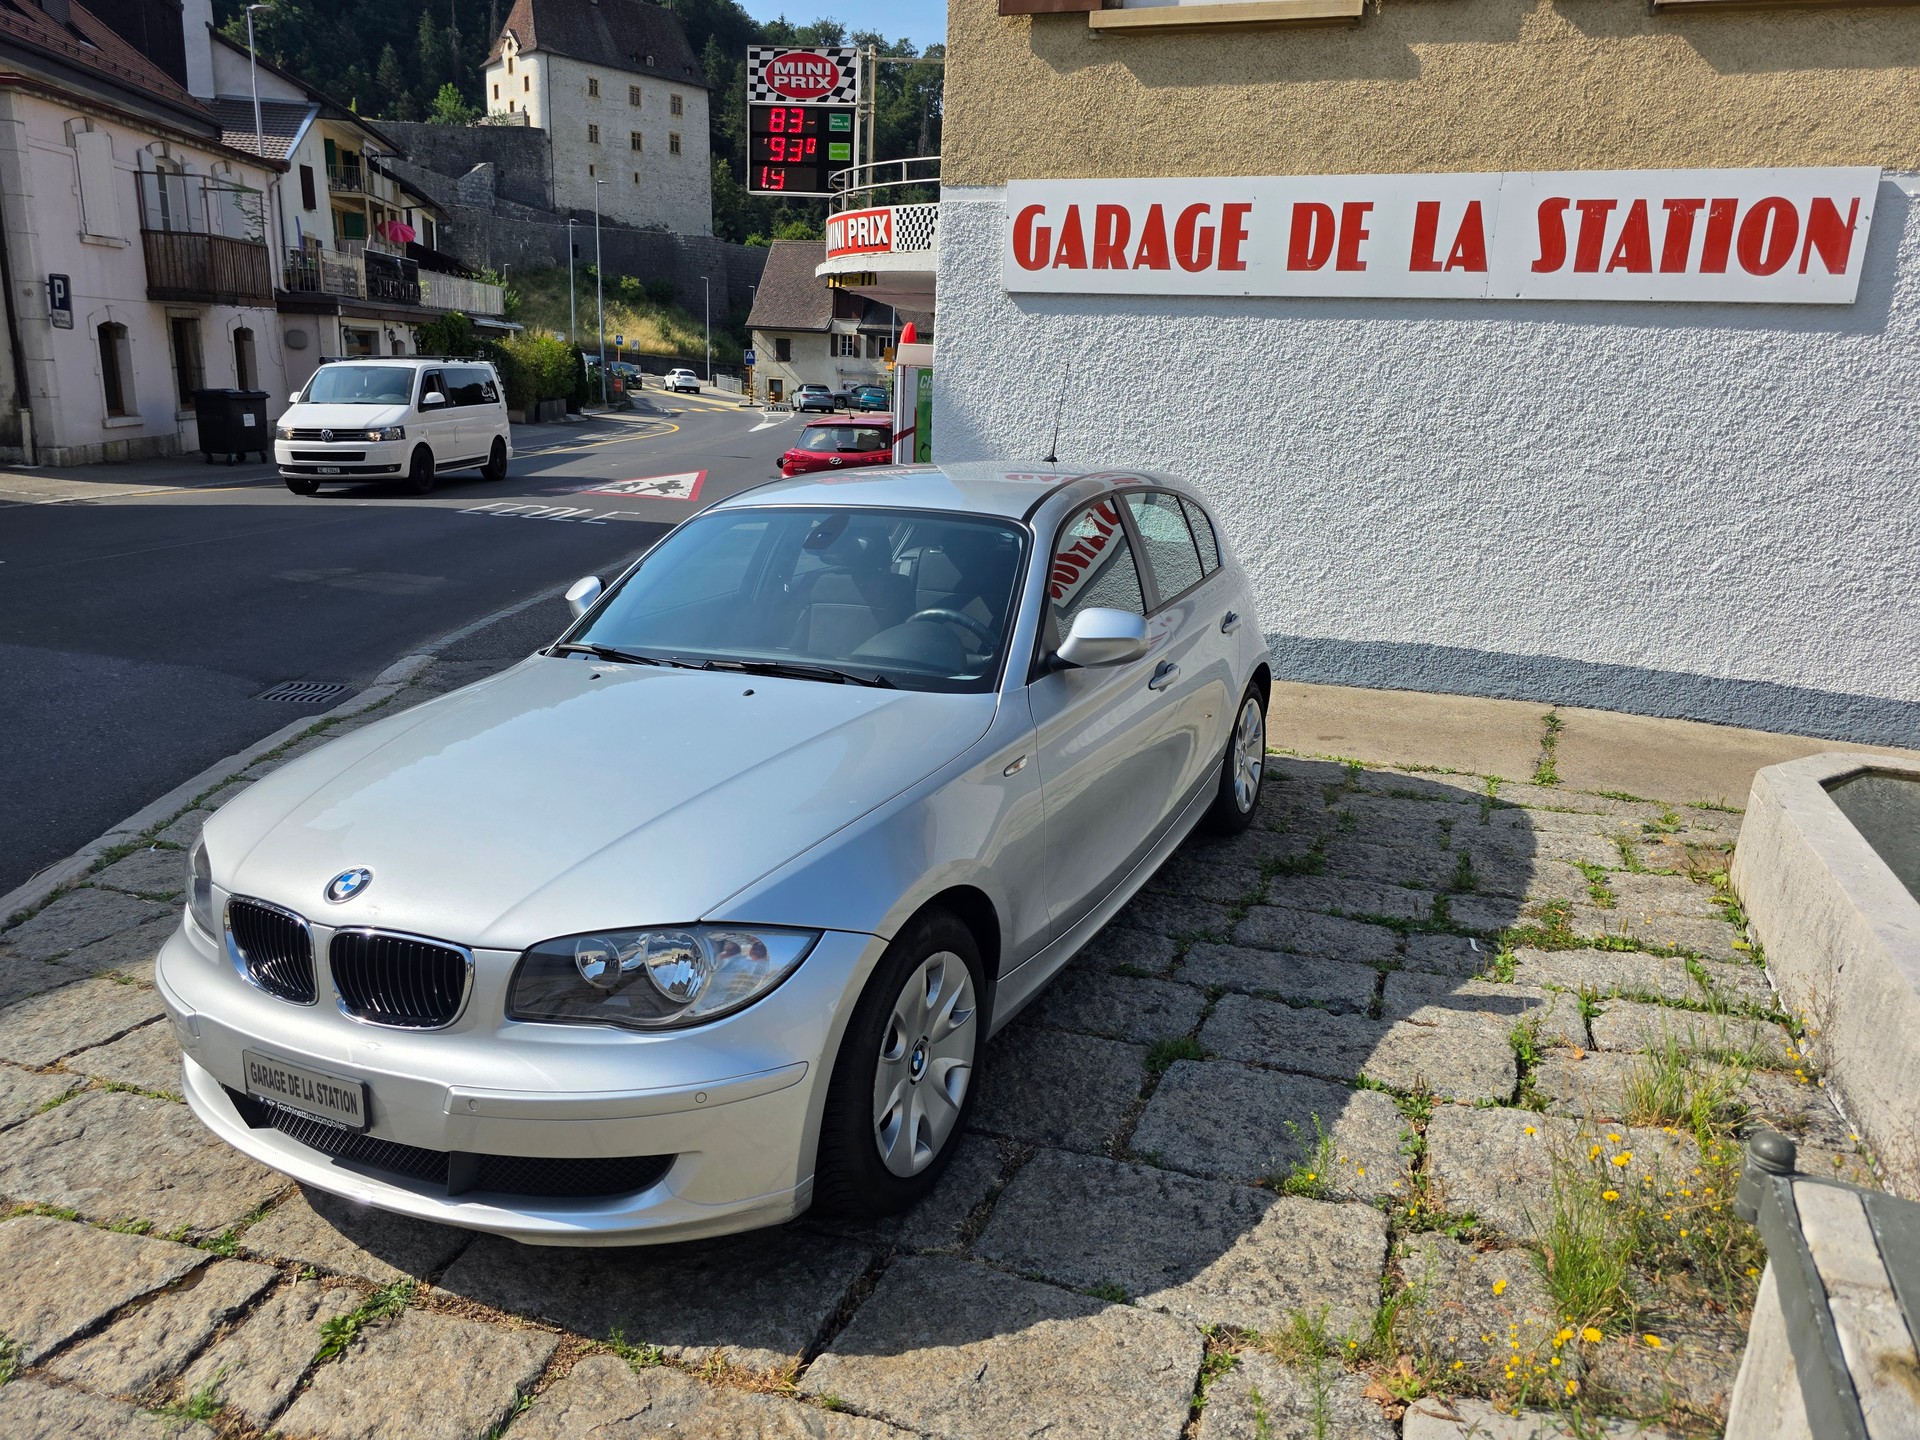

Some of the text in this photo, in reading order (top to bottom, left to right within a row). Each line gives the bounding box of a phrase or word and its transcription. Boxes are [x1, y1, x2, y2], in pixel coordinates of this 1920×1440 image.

[773, 62, 832, 76] MINI
[773, 76, 832, 89] PRIX
[848, 214, 889, 248] PRIX
[1013, 196, 1861, 277] GARAGE DE LA STATION
[53, 279, 65, 307] P
[455, 502, 640, 525] ECOLE
[250, 1061, 358, 1115] GARAGE DE LA STATION
